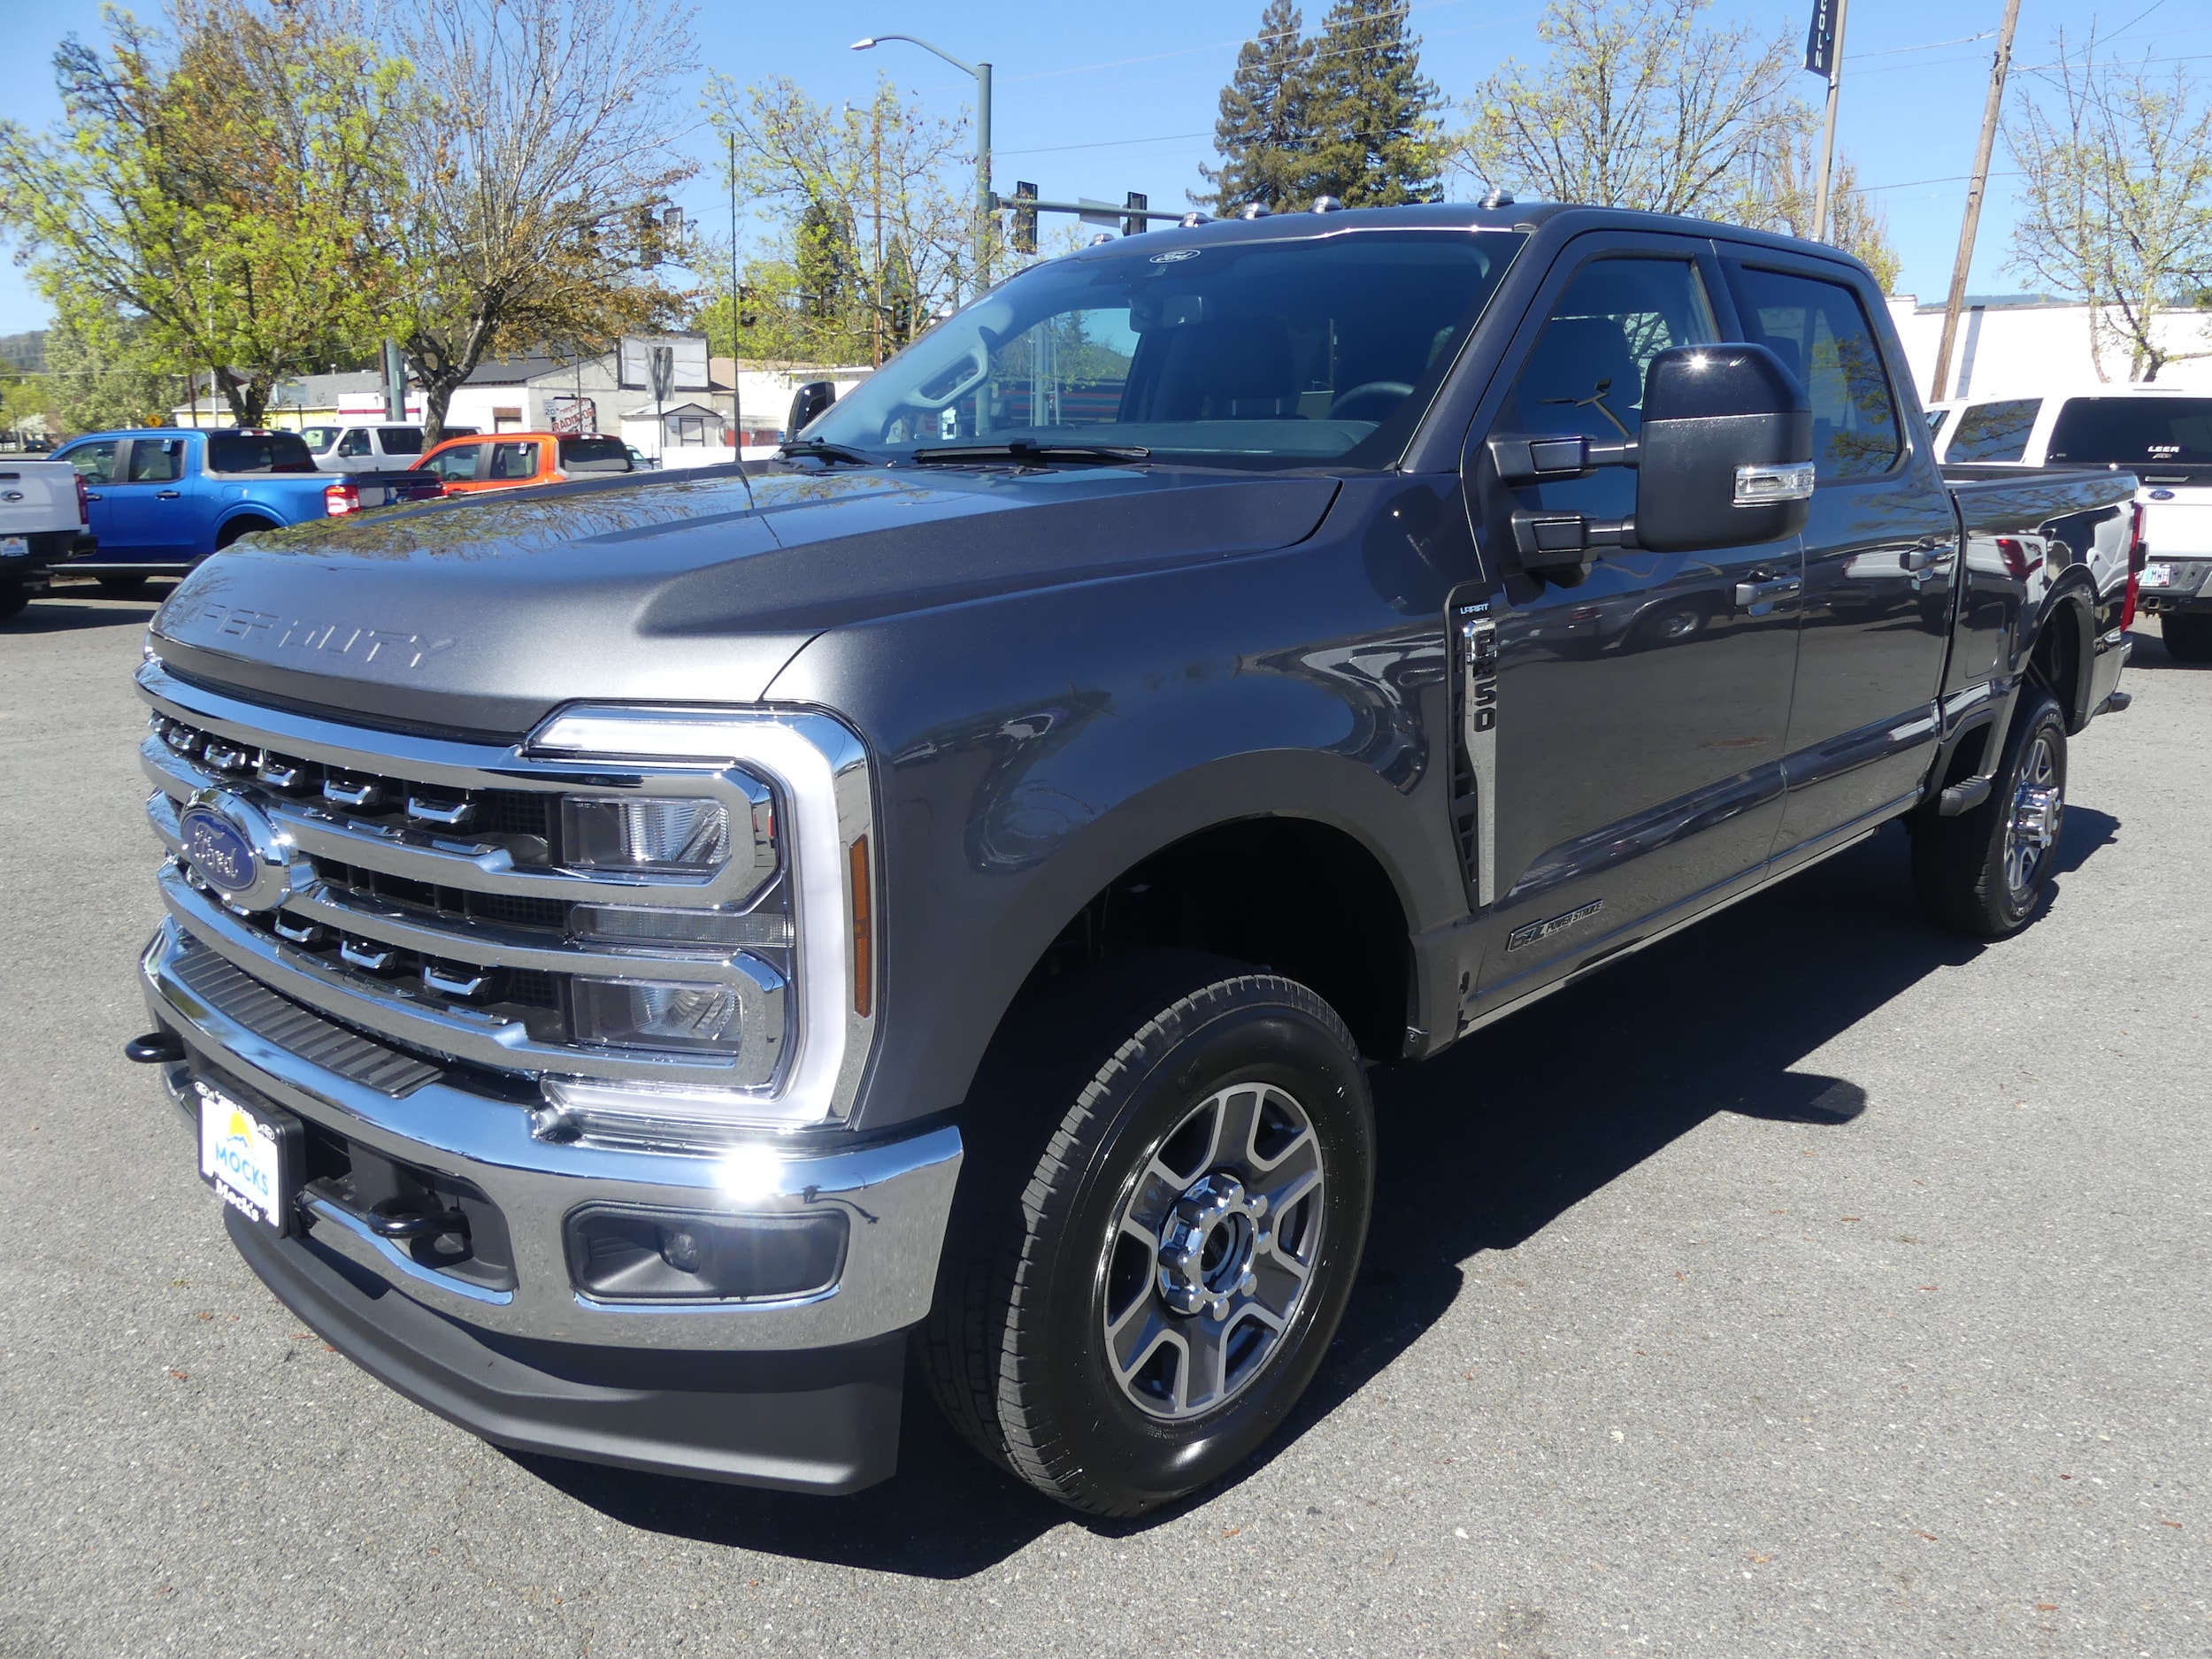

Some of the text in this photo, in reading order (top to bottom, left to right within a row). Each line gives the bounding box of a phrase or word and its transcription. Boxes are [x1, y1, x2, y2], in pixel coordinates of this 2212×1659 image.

[1460, 603, 1489, 615] LARIAT
[278, 619, 457, 668] DUTY
[194, 821, 239, 879] Ford
[215, 1141, 269, 1196] MOCKS
